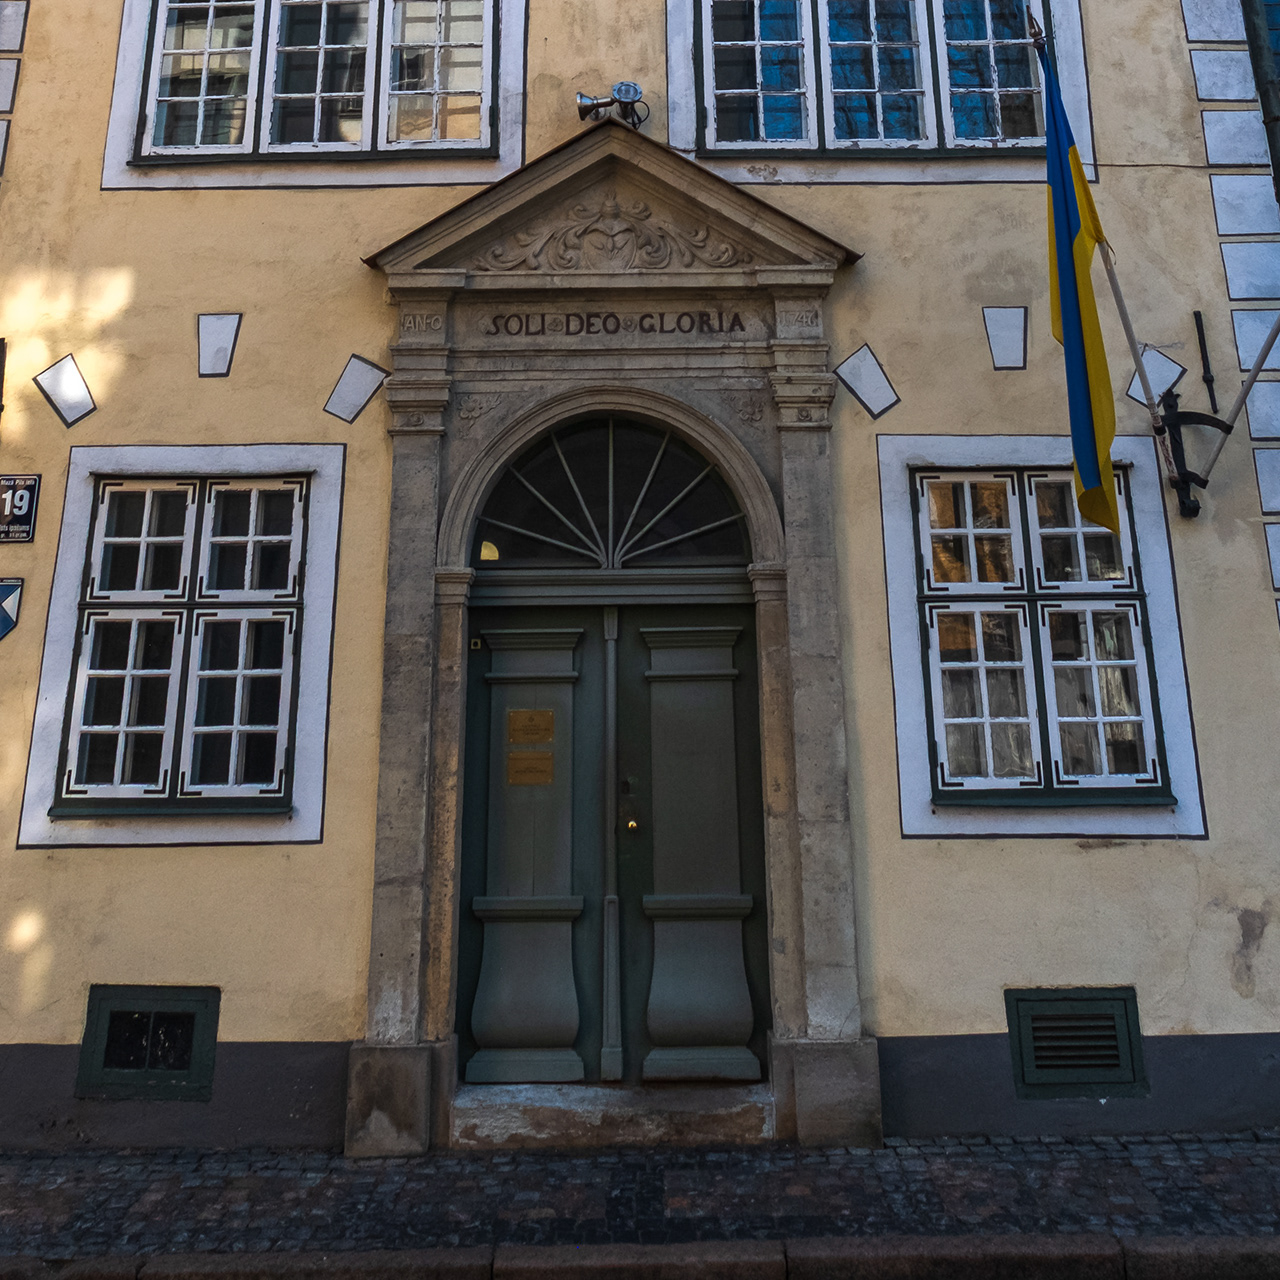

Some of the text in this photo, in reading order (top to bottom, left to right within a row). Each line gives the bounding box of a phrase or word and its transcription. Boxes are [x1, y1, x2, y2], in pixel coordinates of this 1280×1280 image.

[486, 311, 747, 336] SOLI DEO GLORIA
[2, 489, 30, 515] 19
